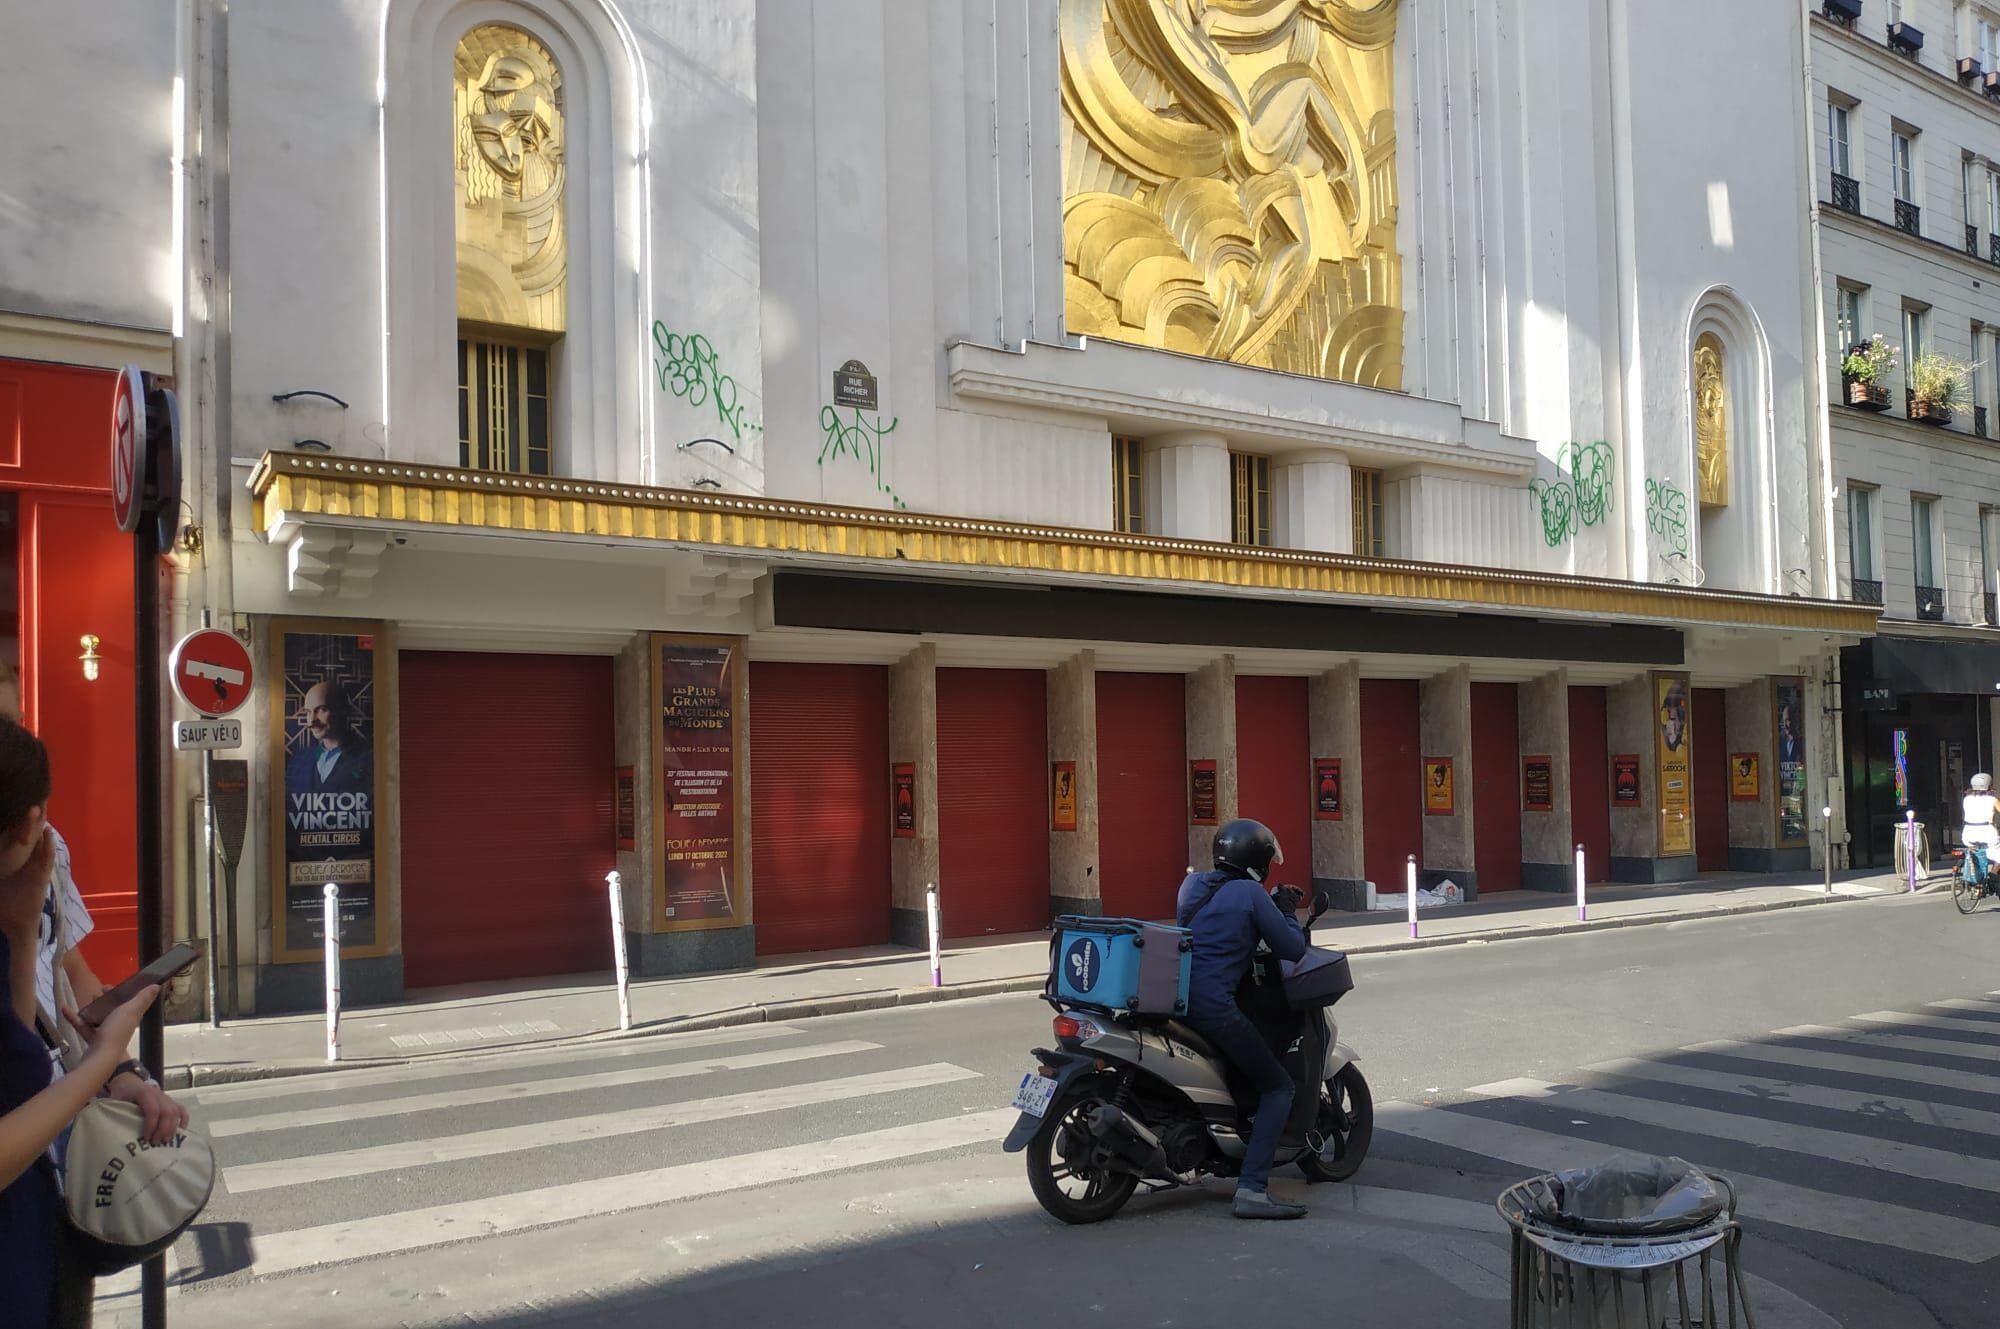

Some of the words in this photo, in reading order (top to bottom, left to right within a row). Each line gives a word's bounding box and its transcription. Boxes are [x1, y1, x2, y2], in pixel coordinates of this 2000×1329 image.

[848, 377, 863, 387] RUE
[843, 385, 868, 397] RICHER
[687, 685, 716, 697] PLUS
[672, 695, 721, 707] GRANDS
[663, 706, 731, 718] MAGICIENS
[680, 718, 724, 729] MONDE
[180, 727, 208, 743] SAUF
[212, 723, 239, 742] VÉLO
[291, 792, 368, 812] VIKTOR
[288, 811, 372, 831] VINCENT
[300, 834, 332, 845] MENTAL
[332, 833, 361, 844] CIRCUS
[668, 852, 684, 861] LUNDI
[685, 852, 691, 860] 17
[691, 851, 715, 860] OCTOBRE
[715, 851, 728, 859] 2022
[95, 1157, 125, 1208] FRED
